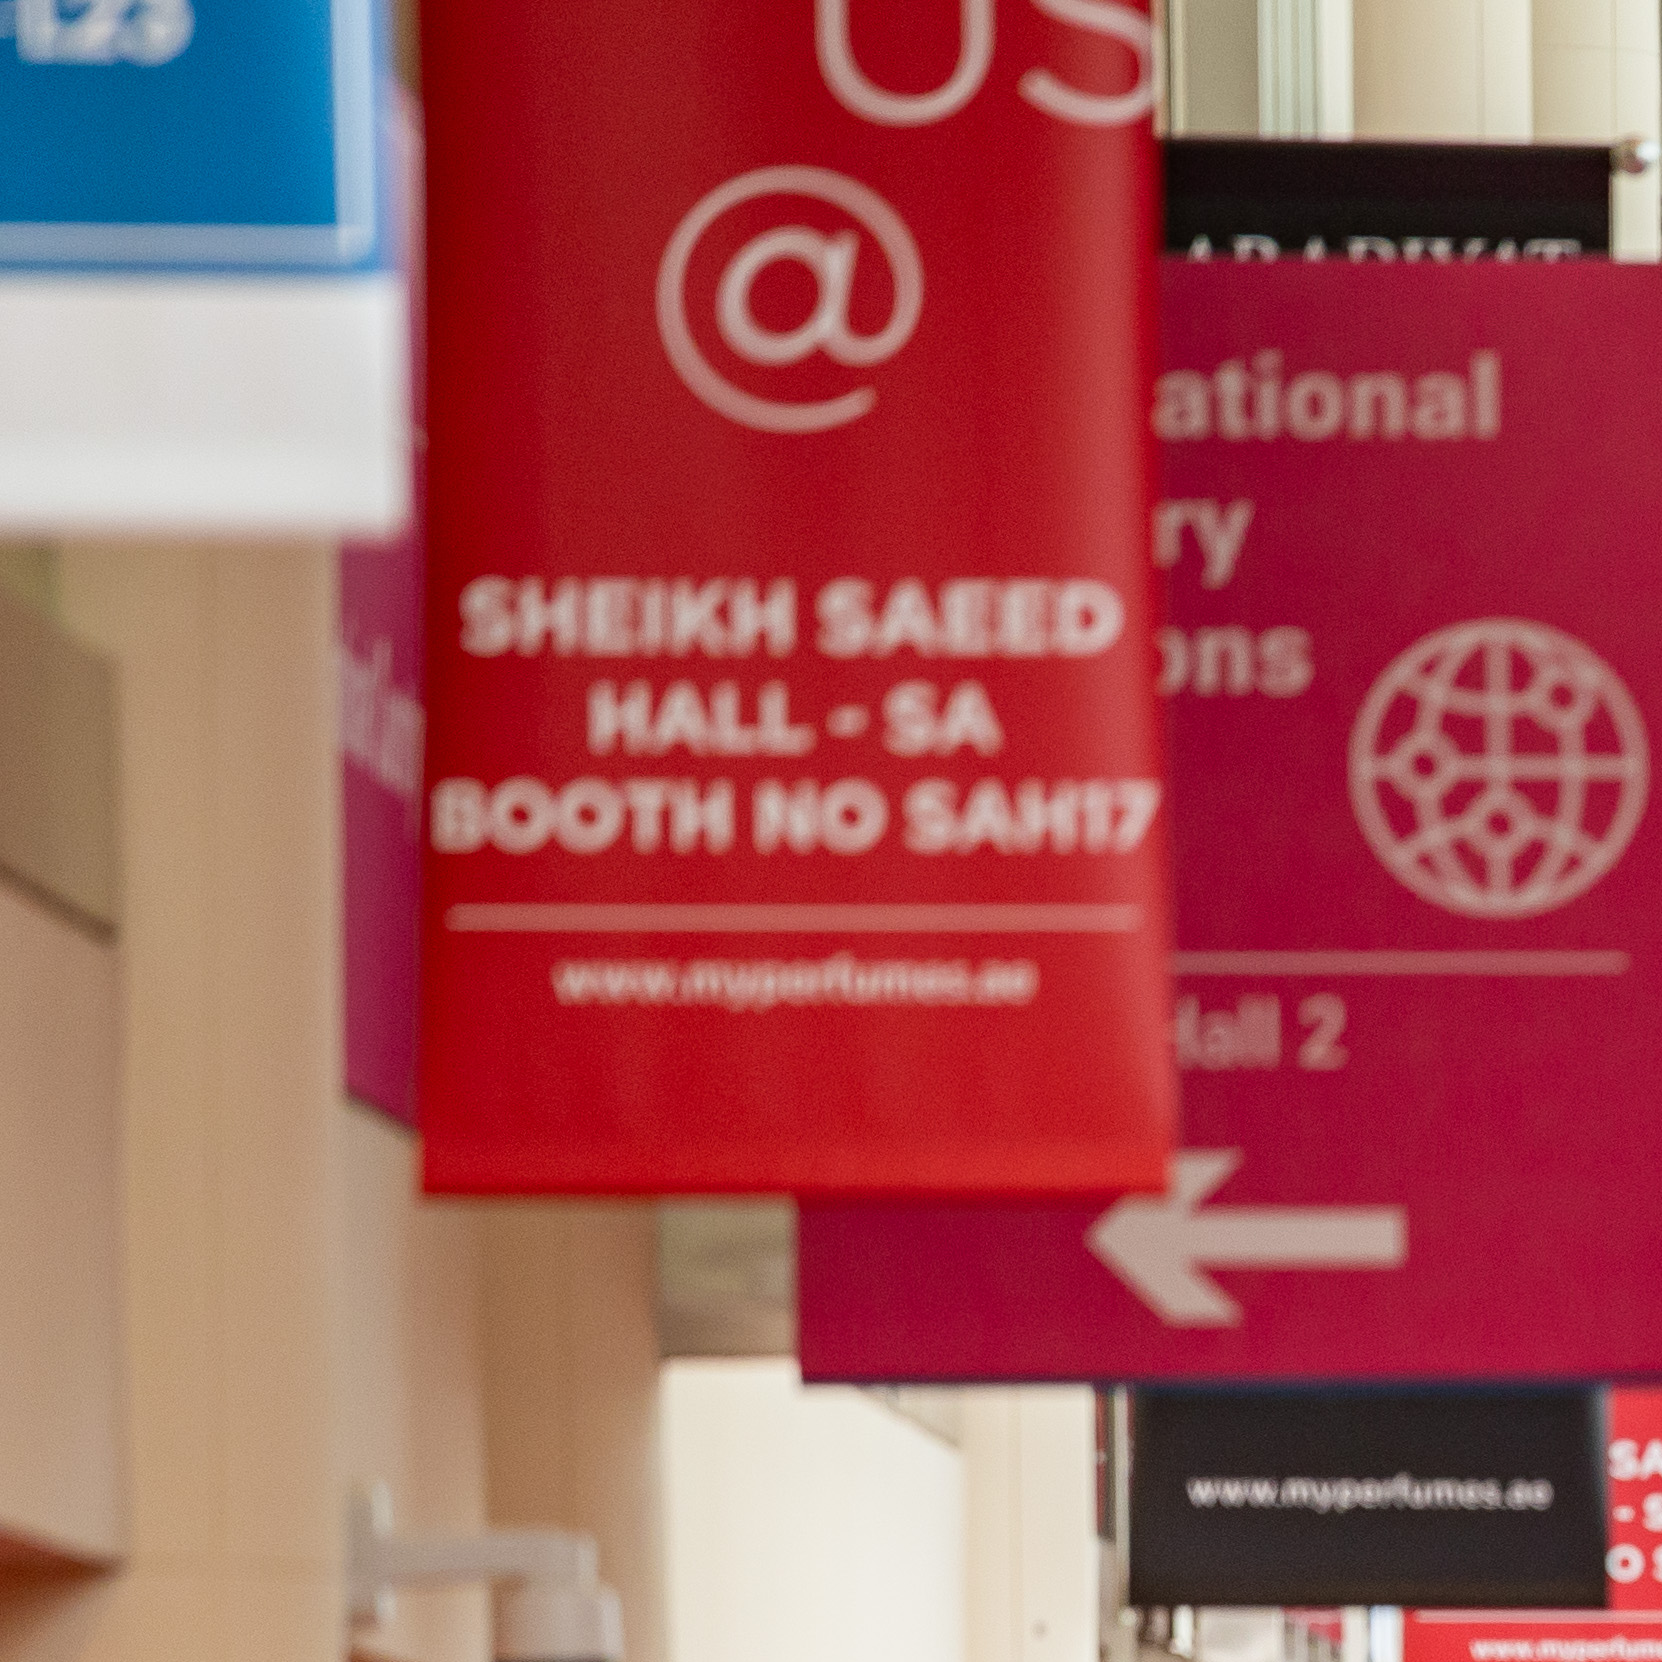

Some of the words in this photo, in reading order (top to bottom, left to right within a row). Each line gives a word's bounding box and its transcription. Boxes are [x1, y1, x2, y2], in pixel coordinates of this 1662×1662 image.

[458, 574, 797, 657] SHEIKH
[815, 576, 1124, 657] SAEED
[588, 681, 815, 756] HALL
[884, 681, 1002, 757] SA
[430, 778, 735, 855] BOOTH
[752, 778, 888, 855] NO
[903, 778, 1161, 855] SAH17
[552, 950, 1039, 1012] www.myperfumes.ae
[1187, 1473, 1553, 1514] www.myperfumes.ae
